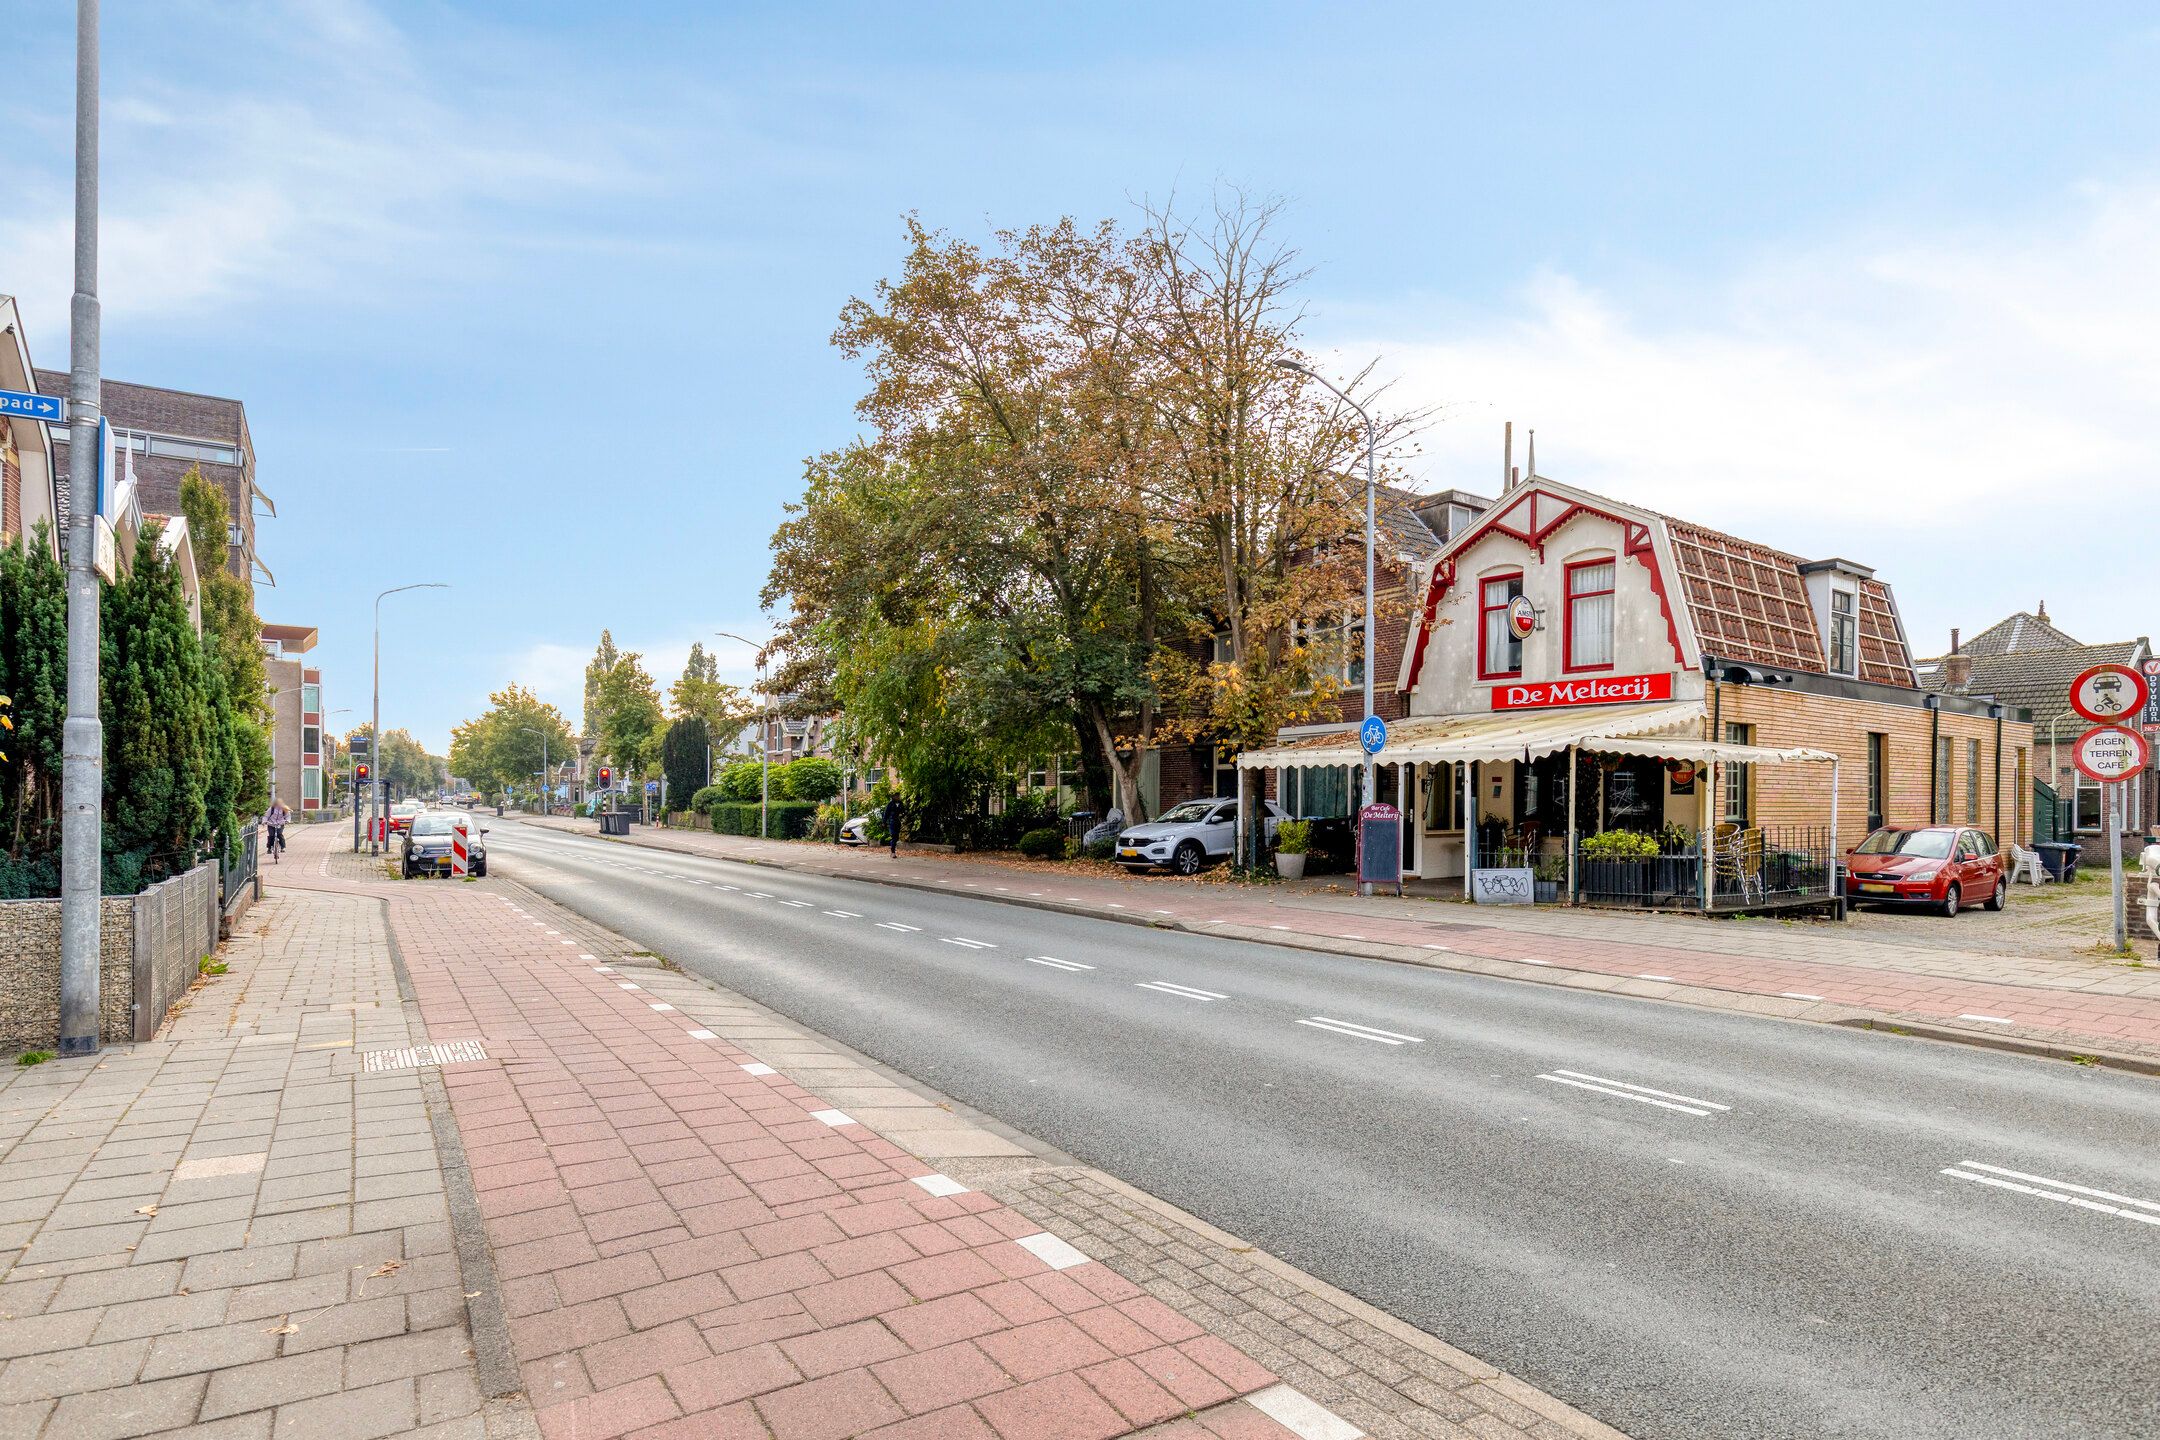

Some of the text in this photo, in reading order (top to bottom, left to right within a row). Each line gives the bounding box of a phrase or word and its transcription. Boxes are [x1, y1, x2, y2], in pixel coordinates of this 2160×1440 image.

[1507, 677, 1653, 705] De Melterij
[2095, 737, 2126, 746] EIGEN
[2089, 749, 2133, 758] TERREIN
[2097, 759, 2125, 769] CAFÉ
